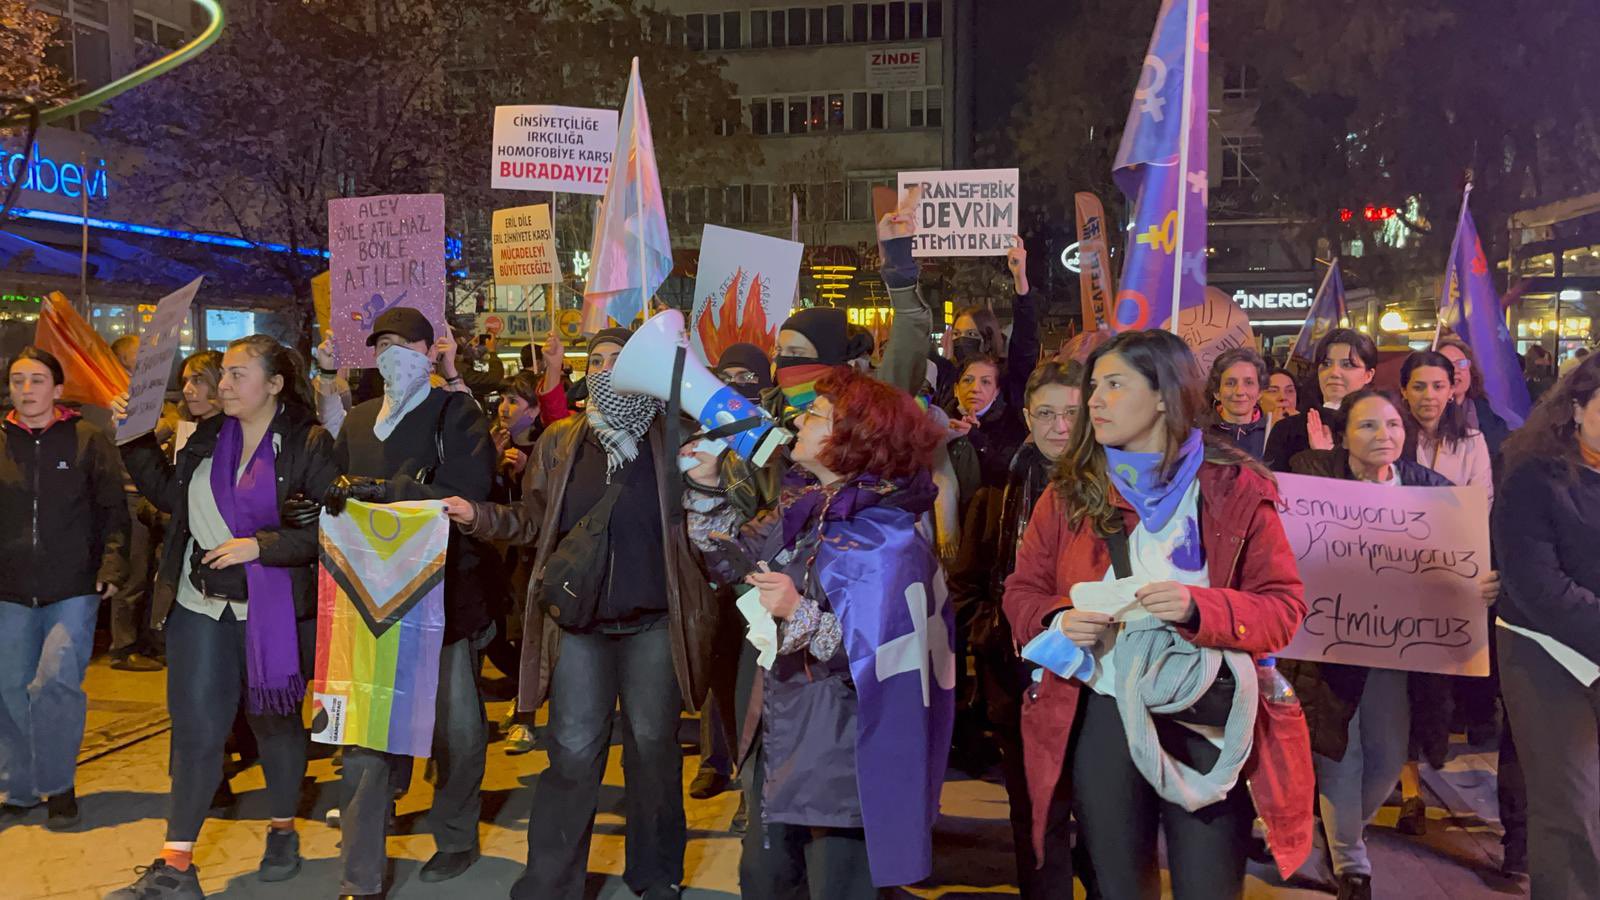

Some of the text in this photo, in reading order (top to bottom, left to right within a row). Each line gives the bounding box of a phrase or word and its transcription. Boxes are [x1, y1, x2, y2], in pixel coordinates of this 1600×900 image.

[513, 113, 600, 131] CİNSİYETÇİLİĞE
[527, 130, 584, 145] IRKÇILIĞA
[498, 145, 612, 164] HOMOFOBİYE KARŞI
[500, 161, 609, 184] BURADAYIZ!
[359, 198, 399, 218] ALEV
[922, 199, 1013, 229] DEVRİM
[337, 215, 431, 241] ÖYLE ATILMAZ
[359, 239, 408, 261] BÖYLE
[911, 230, 1013, 250] STEMİYORUZ
[501, 242, 545, 260] MÜCADELEYİ
[345, 260, 426, 292] ATILIR!
[500, 260, 552, 276] BÜYÜTECEĞİZ!
[1277, 498, 1431, 540] usmuyoruz
[1299, 522, 1479, 578] Korkmuyoruz
